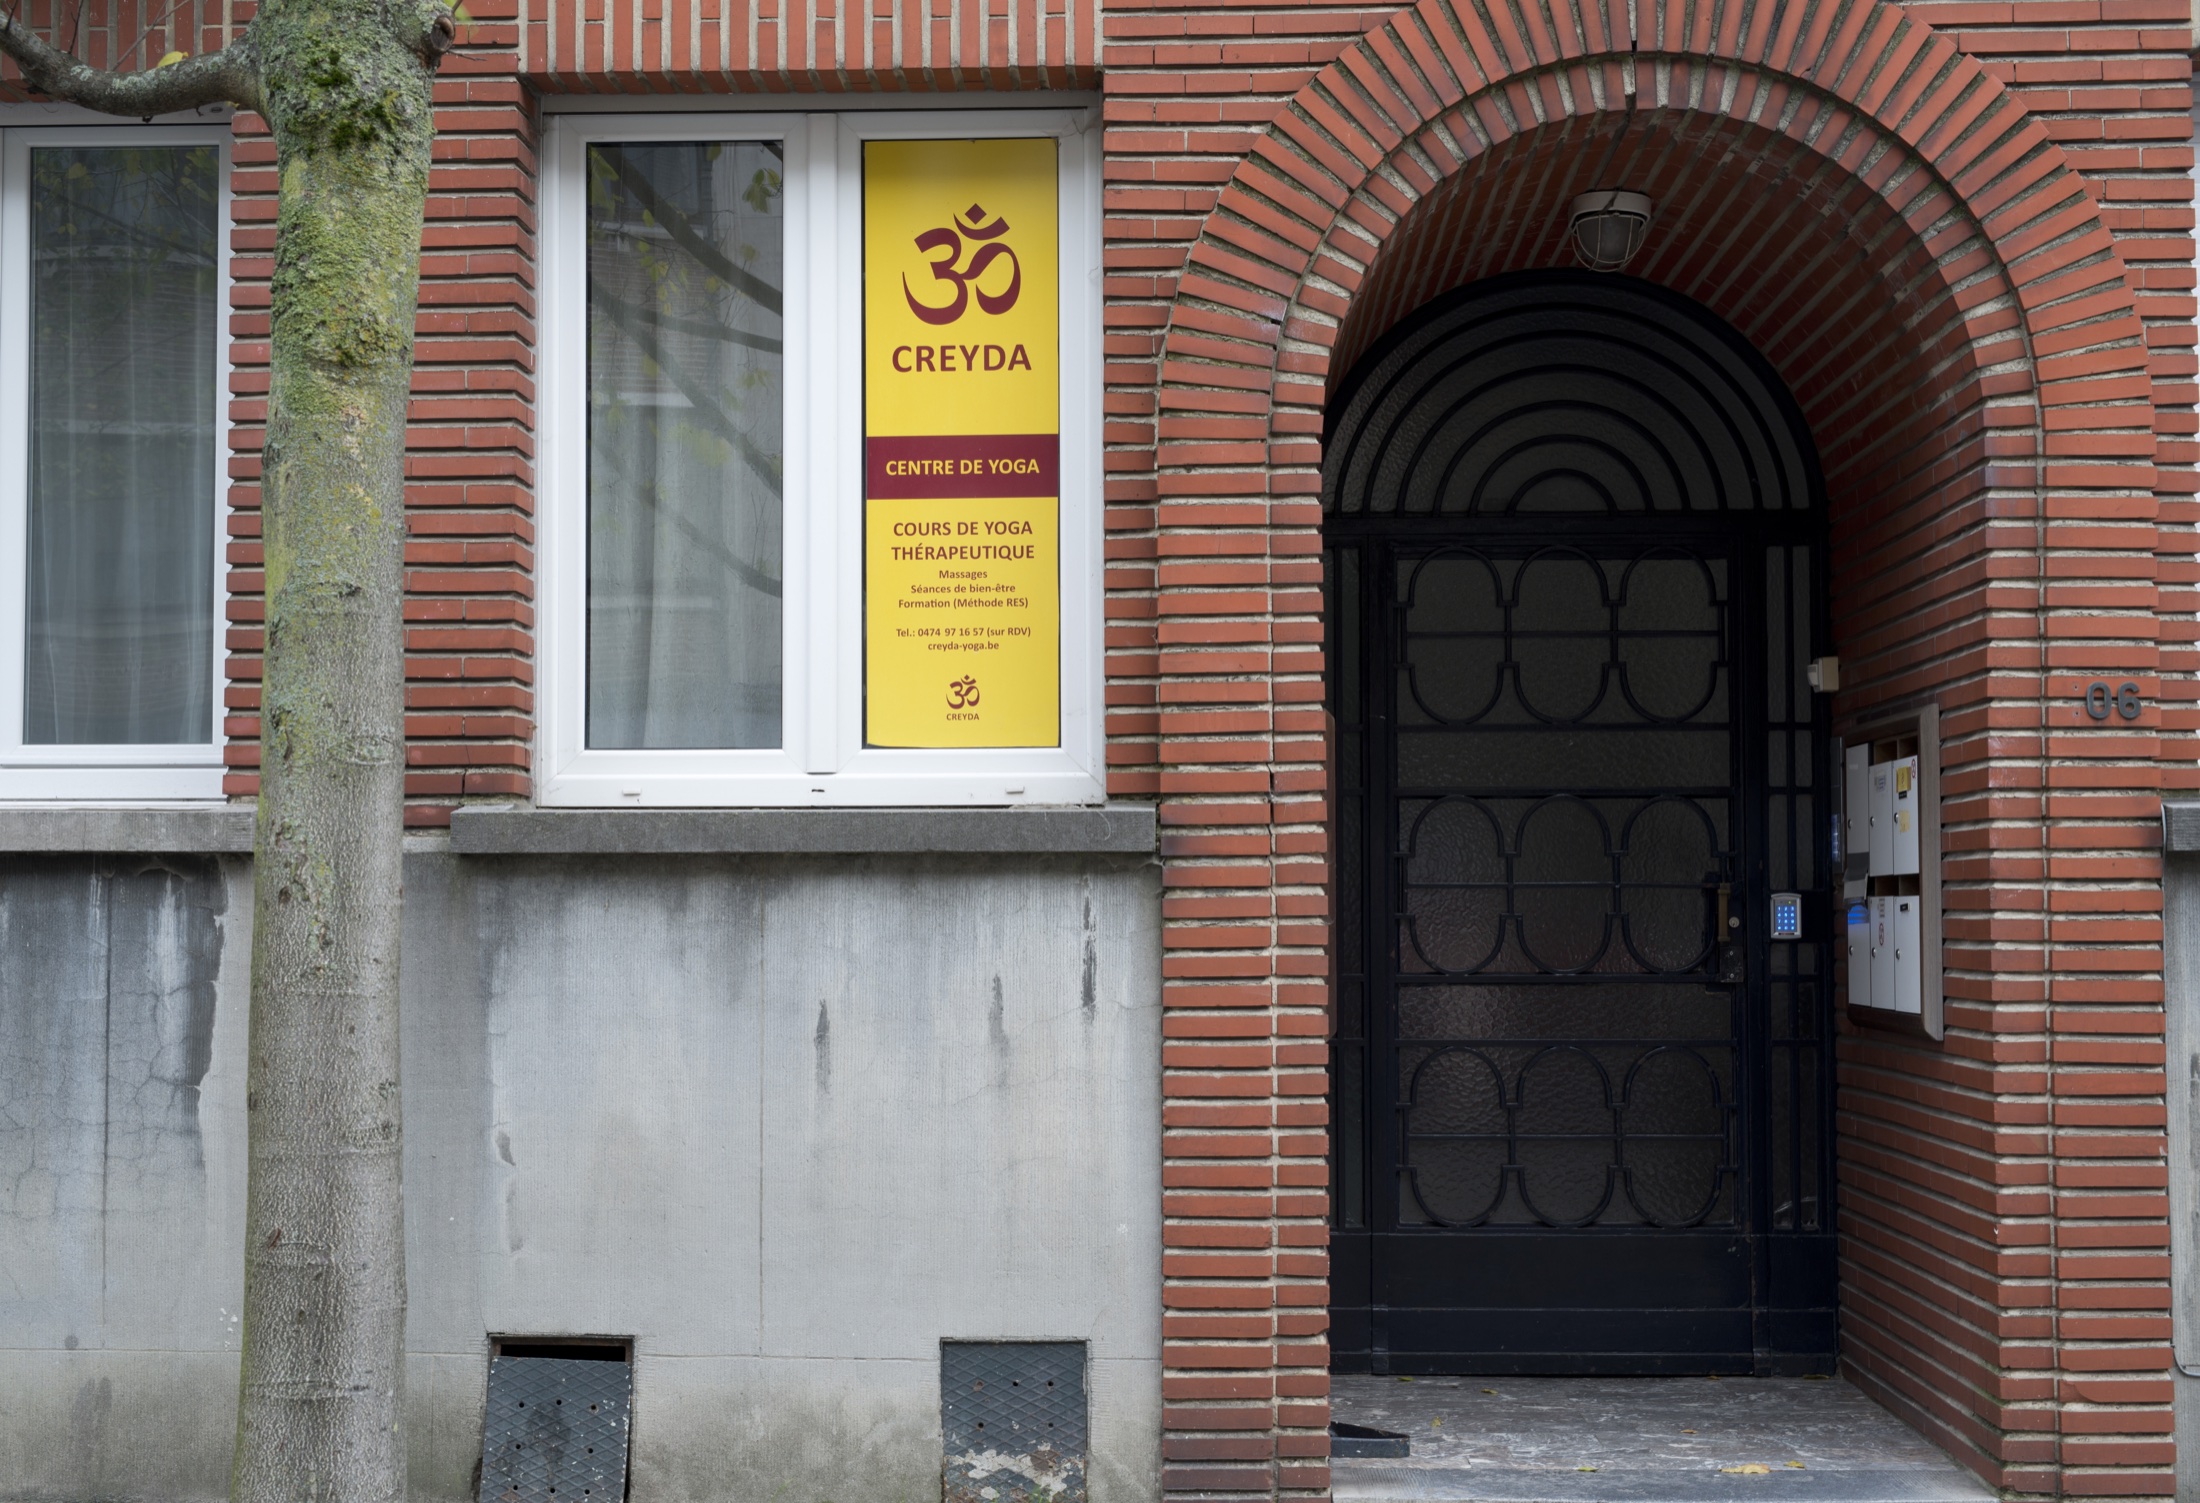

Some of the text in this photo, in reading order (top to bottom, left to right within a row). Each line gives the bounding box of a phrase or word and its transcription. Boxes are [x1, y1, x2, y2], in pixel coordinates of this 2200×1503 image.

[891, 343, 1032, 373] CREYDA
[885, 458, 1040, 476] CENTRE DE YOGA
[893, 520, 1033, 537] COURS DE YOGA
[891, 542, 1035, 561] THÉRAPEUTIQUE
[938, 569, 988, 580] Massages
[910, 583, 1016, 594] Séances de bien-être
[898, 597, 1029, 610] Formation (Méthode RES)
[896, 626, 1032, 638] Tel.: 0474 97 16 57 (sur RDV)
[927, 640, 1000, 652] creyda-yoga.be
[2086, 681, 2142, 720] 06
[946, 712, 980, 721] CREYDA
